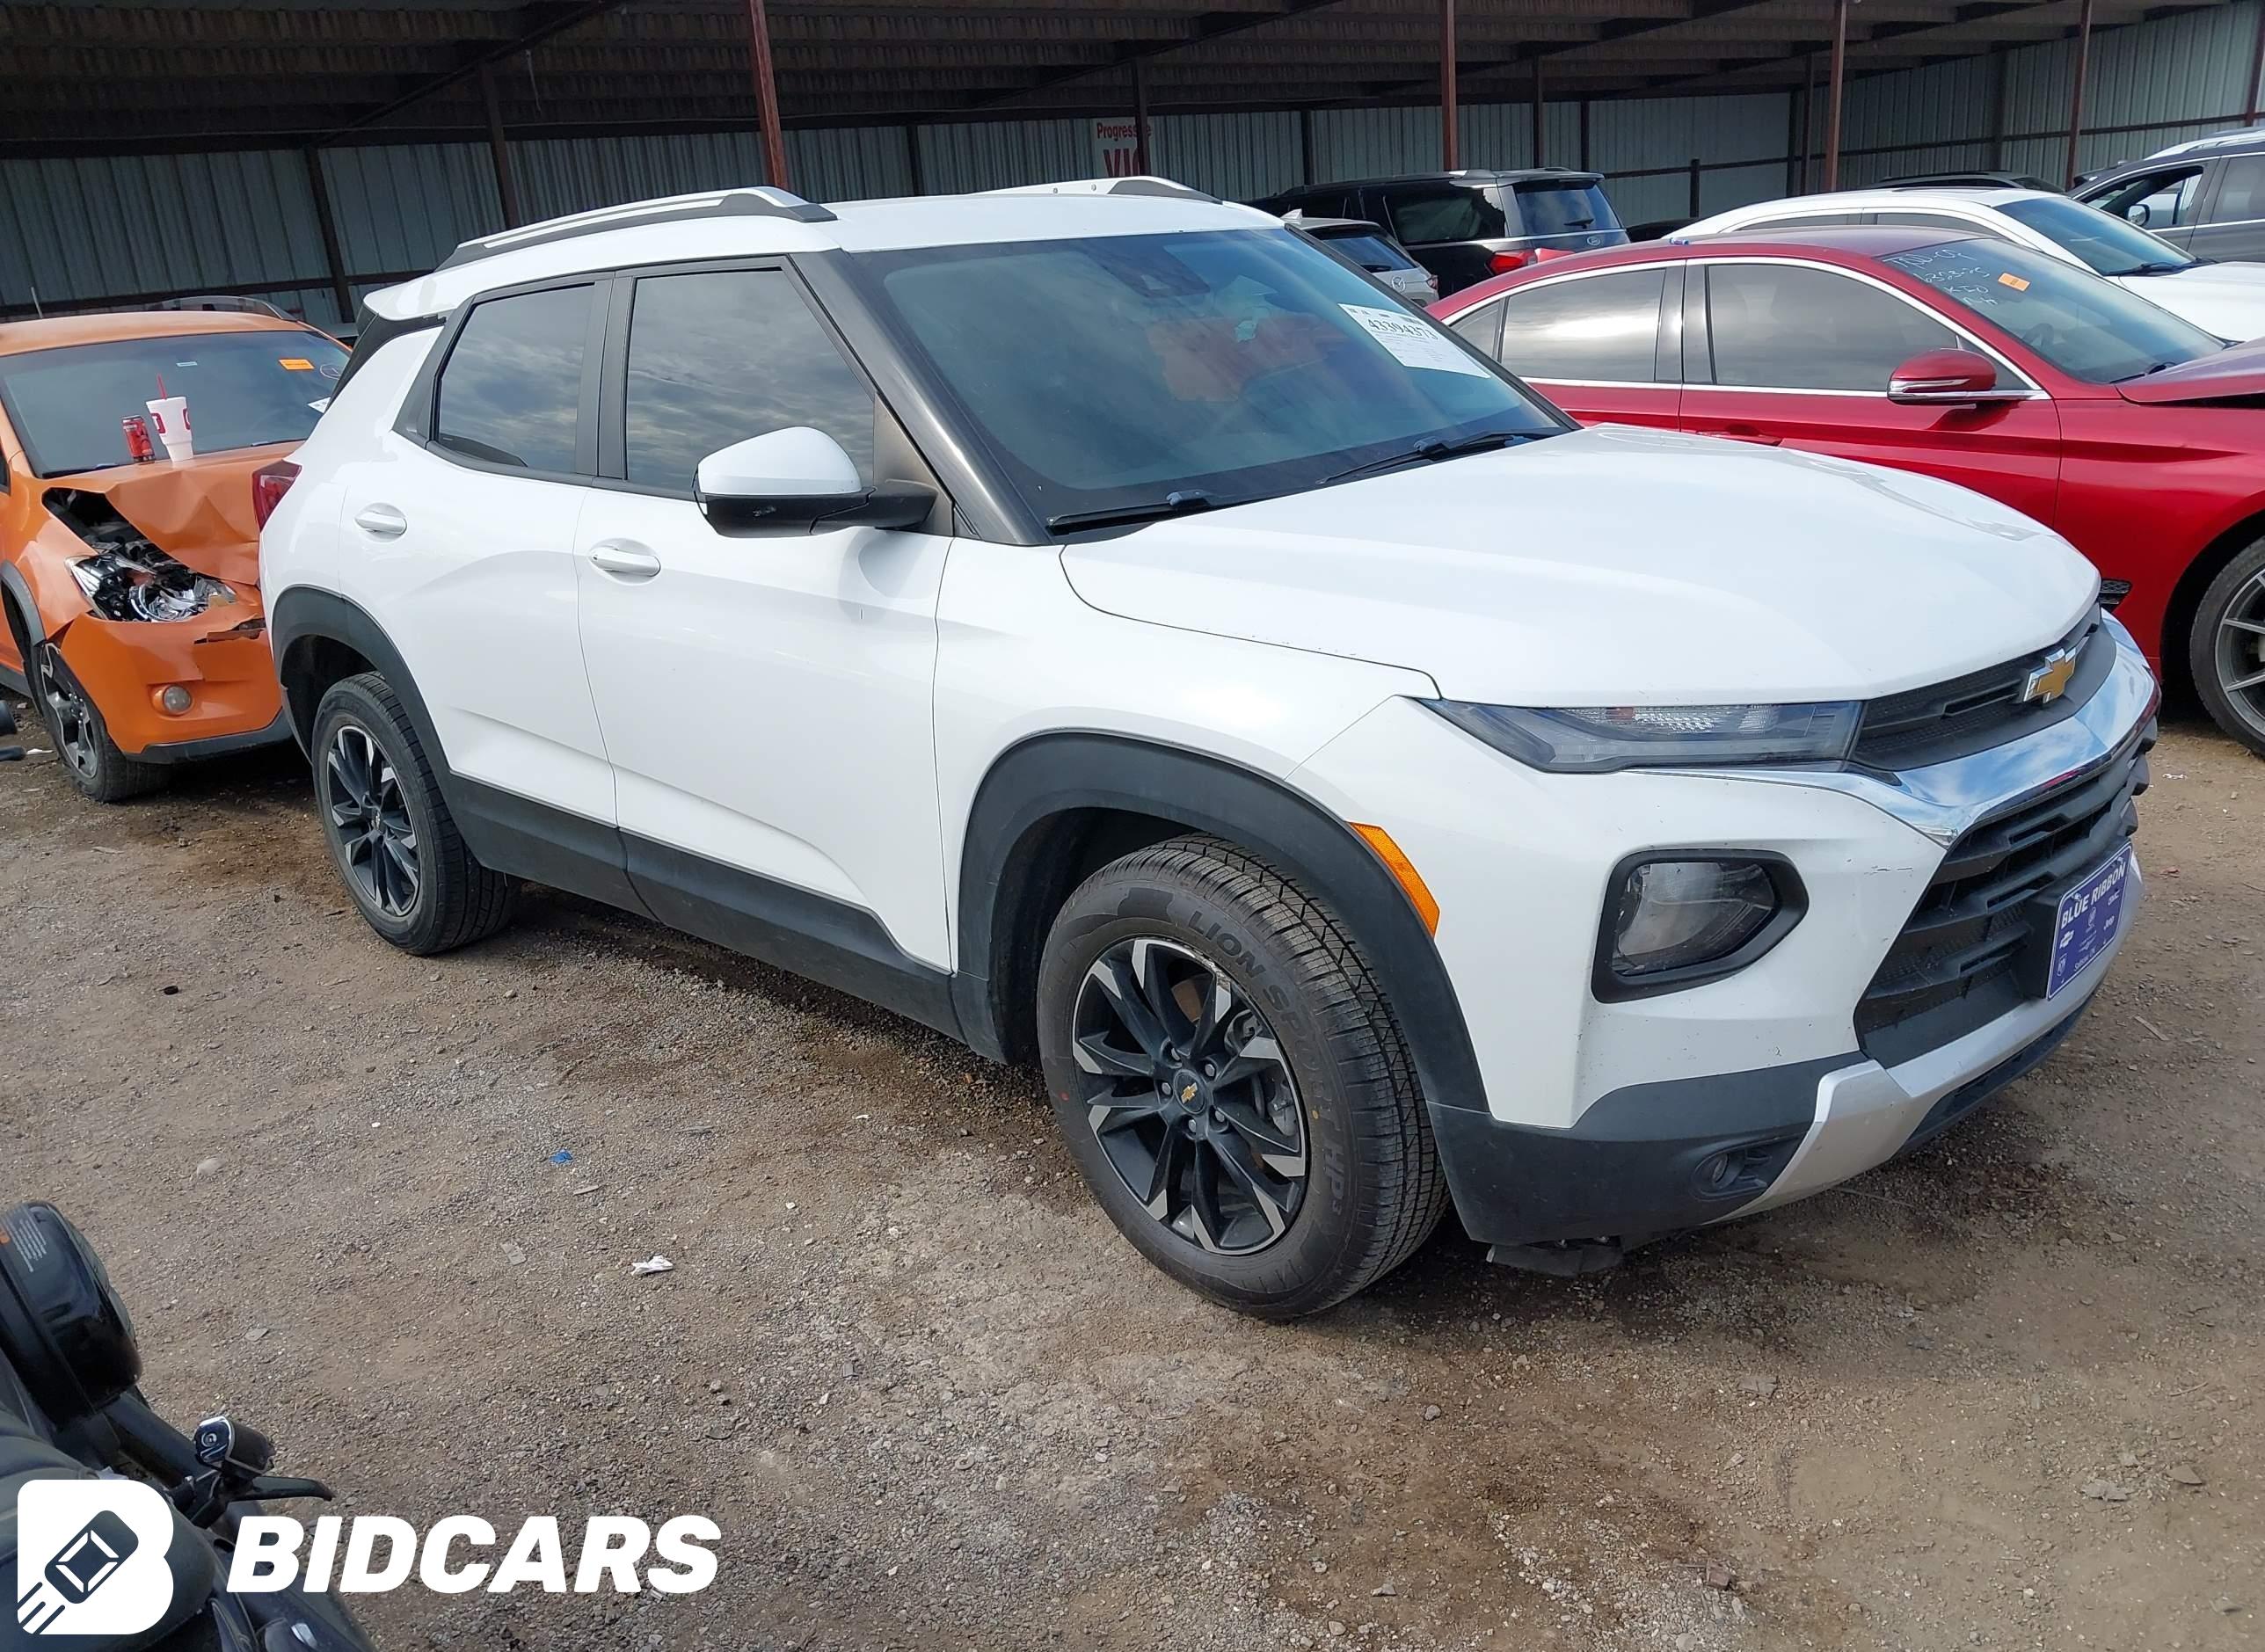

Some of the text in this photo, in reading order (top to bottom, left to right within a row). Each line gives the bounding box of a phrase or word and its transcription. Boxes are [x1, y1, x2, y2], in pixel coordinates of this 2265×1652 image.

[1367, 319, 1438, 340] 43394373
[2060, 862, 2126, 930] BLUE RIBBON
[1188, 910, 1266, 979] LION
